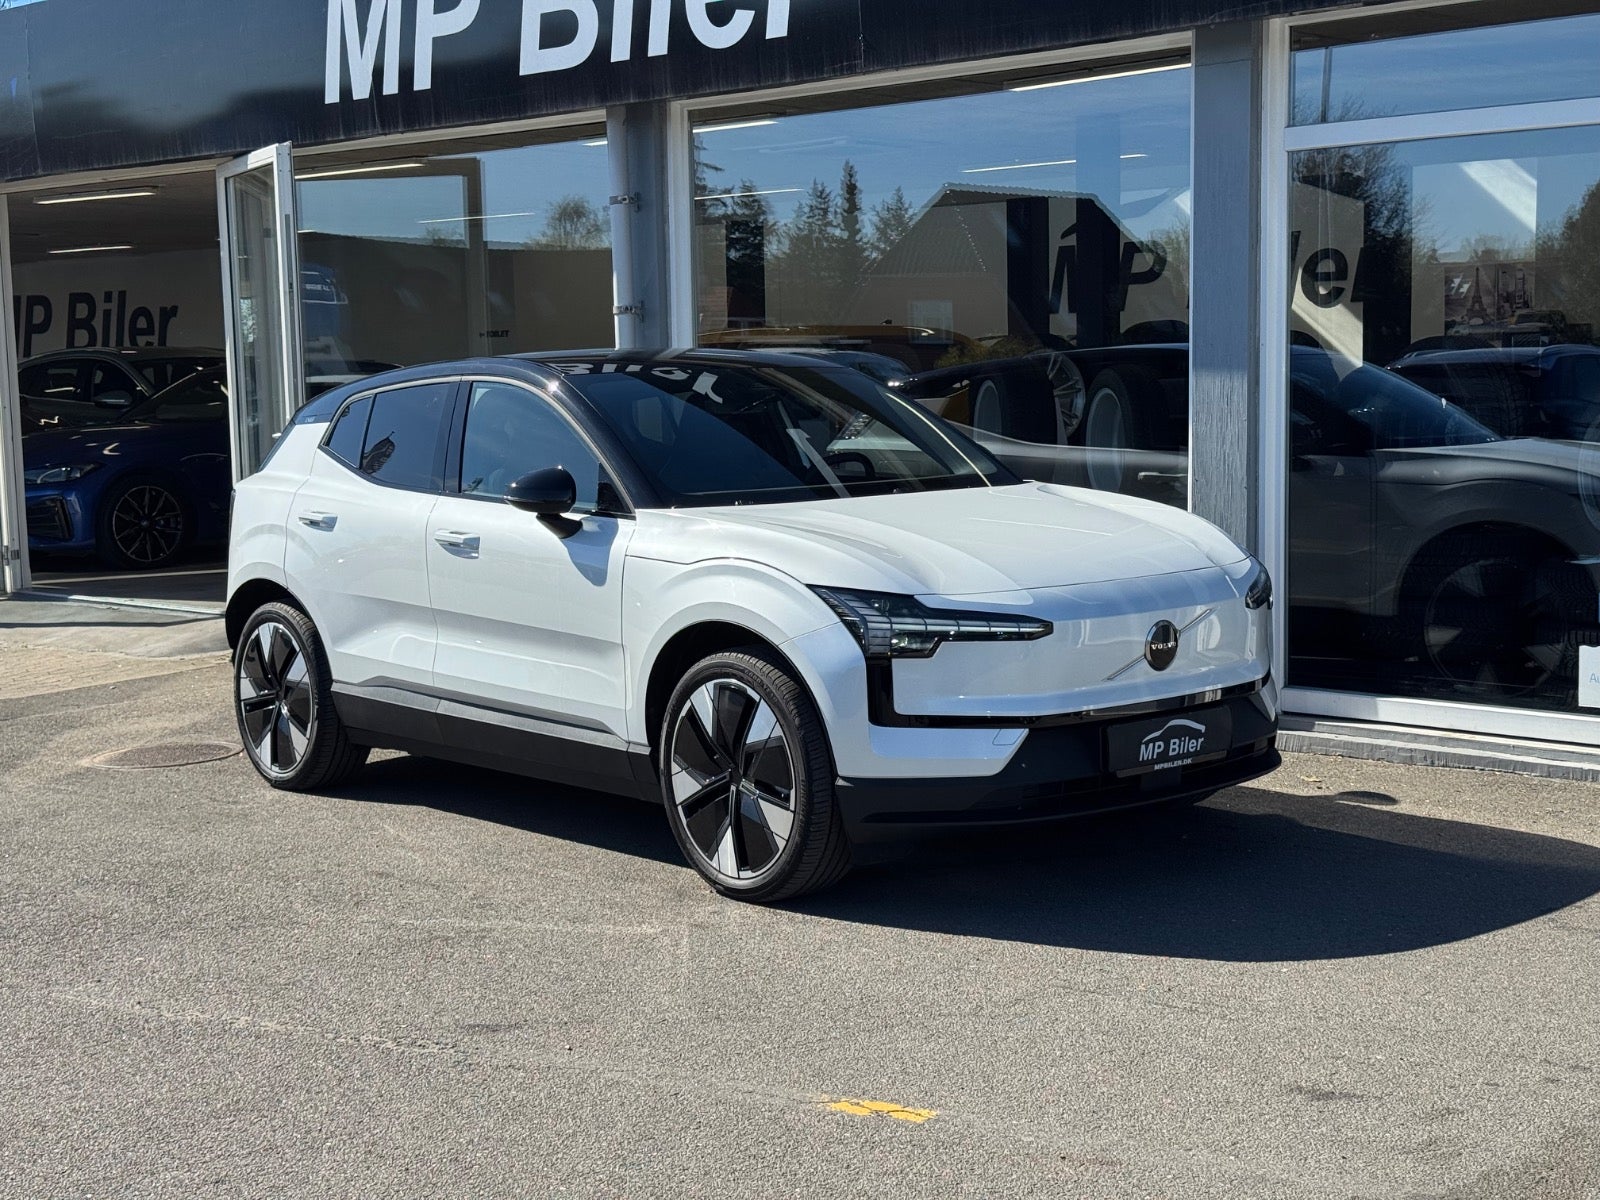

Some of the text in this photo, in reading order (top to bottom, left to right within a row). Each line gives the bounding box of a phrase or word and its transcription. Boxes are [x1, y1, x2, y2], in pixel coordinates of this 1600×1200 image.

[324, 0, 481, 104] MP
[13, 290, 179, 358] P Biler
[1151, 641, 1176, 650] VOLVO
[1139, 736, 1205, 761] MP Biler
[1154, 758, 1193, 770] MPBILER.DK
